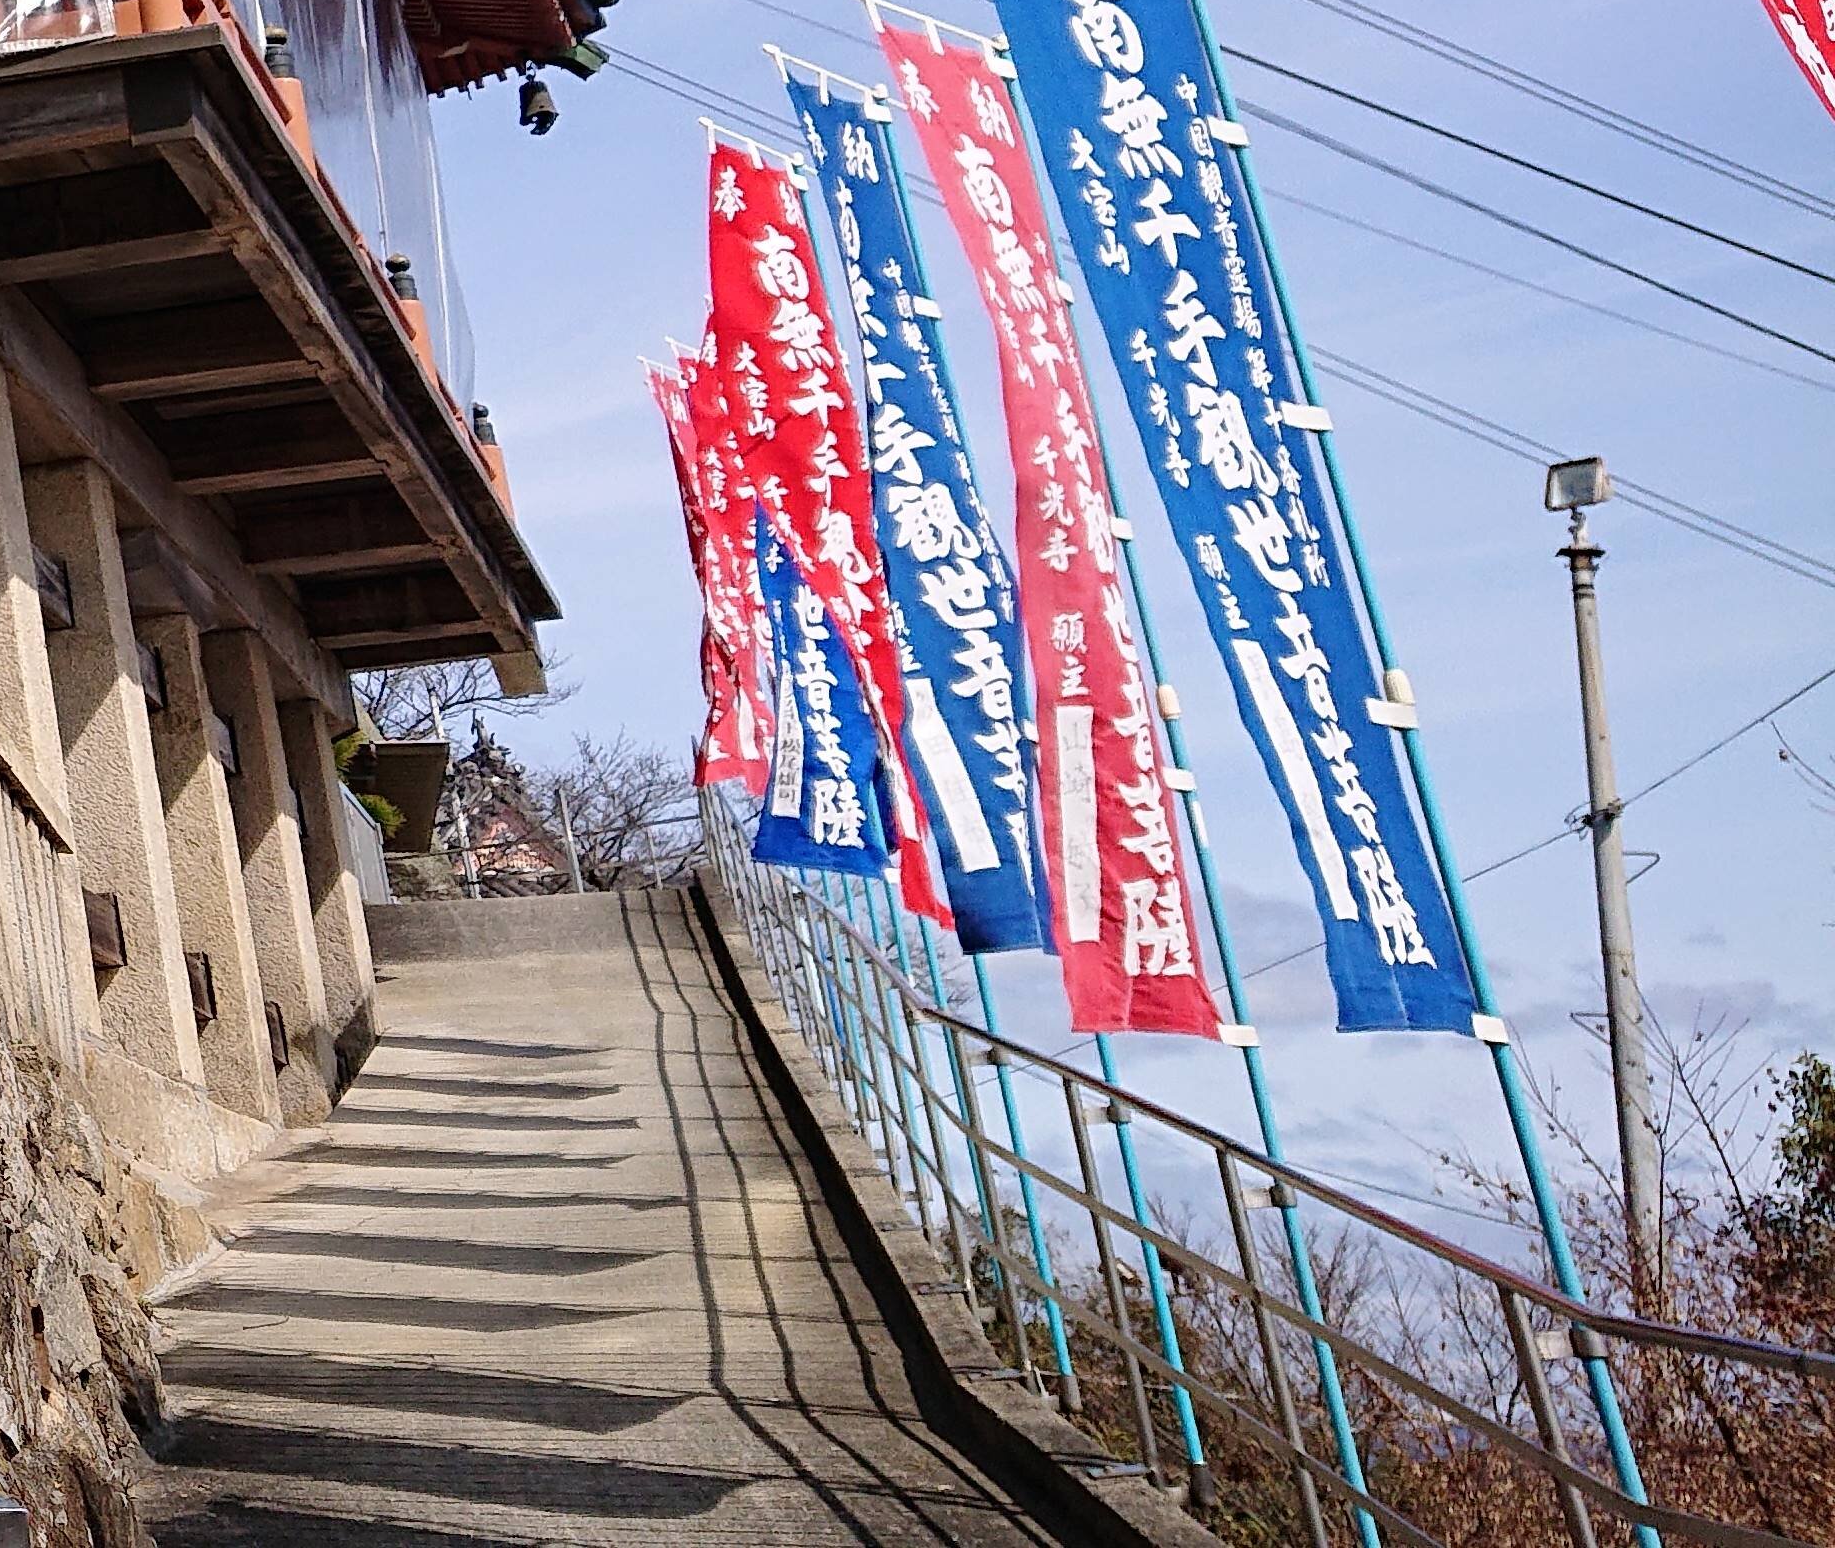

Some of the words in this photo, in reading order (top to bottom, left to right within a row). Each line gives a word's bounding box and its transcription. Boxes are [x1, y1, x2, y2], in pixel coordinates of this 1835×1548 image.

[898, 58, 1016, 150] 奉納
[734, 339, 776, 441] 大宝山
[1032, 434, 1080, 574] 千光寺
[1050, 612, 1091, 699] 願主
